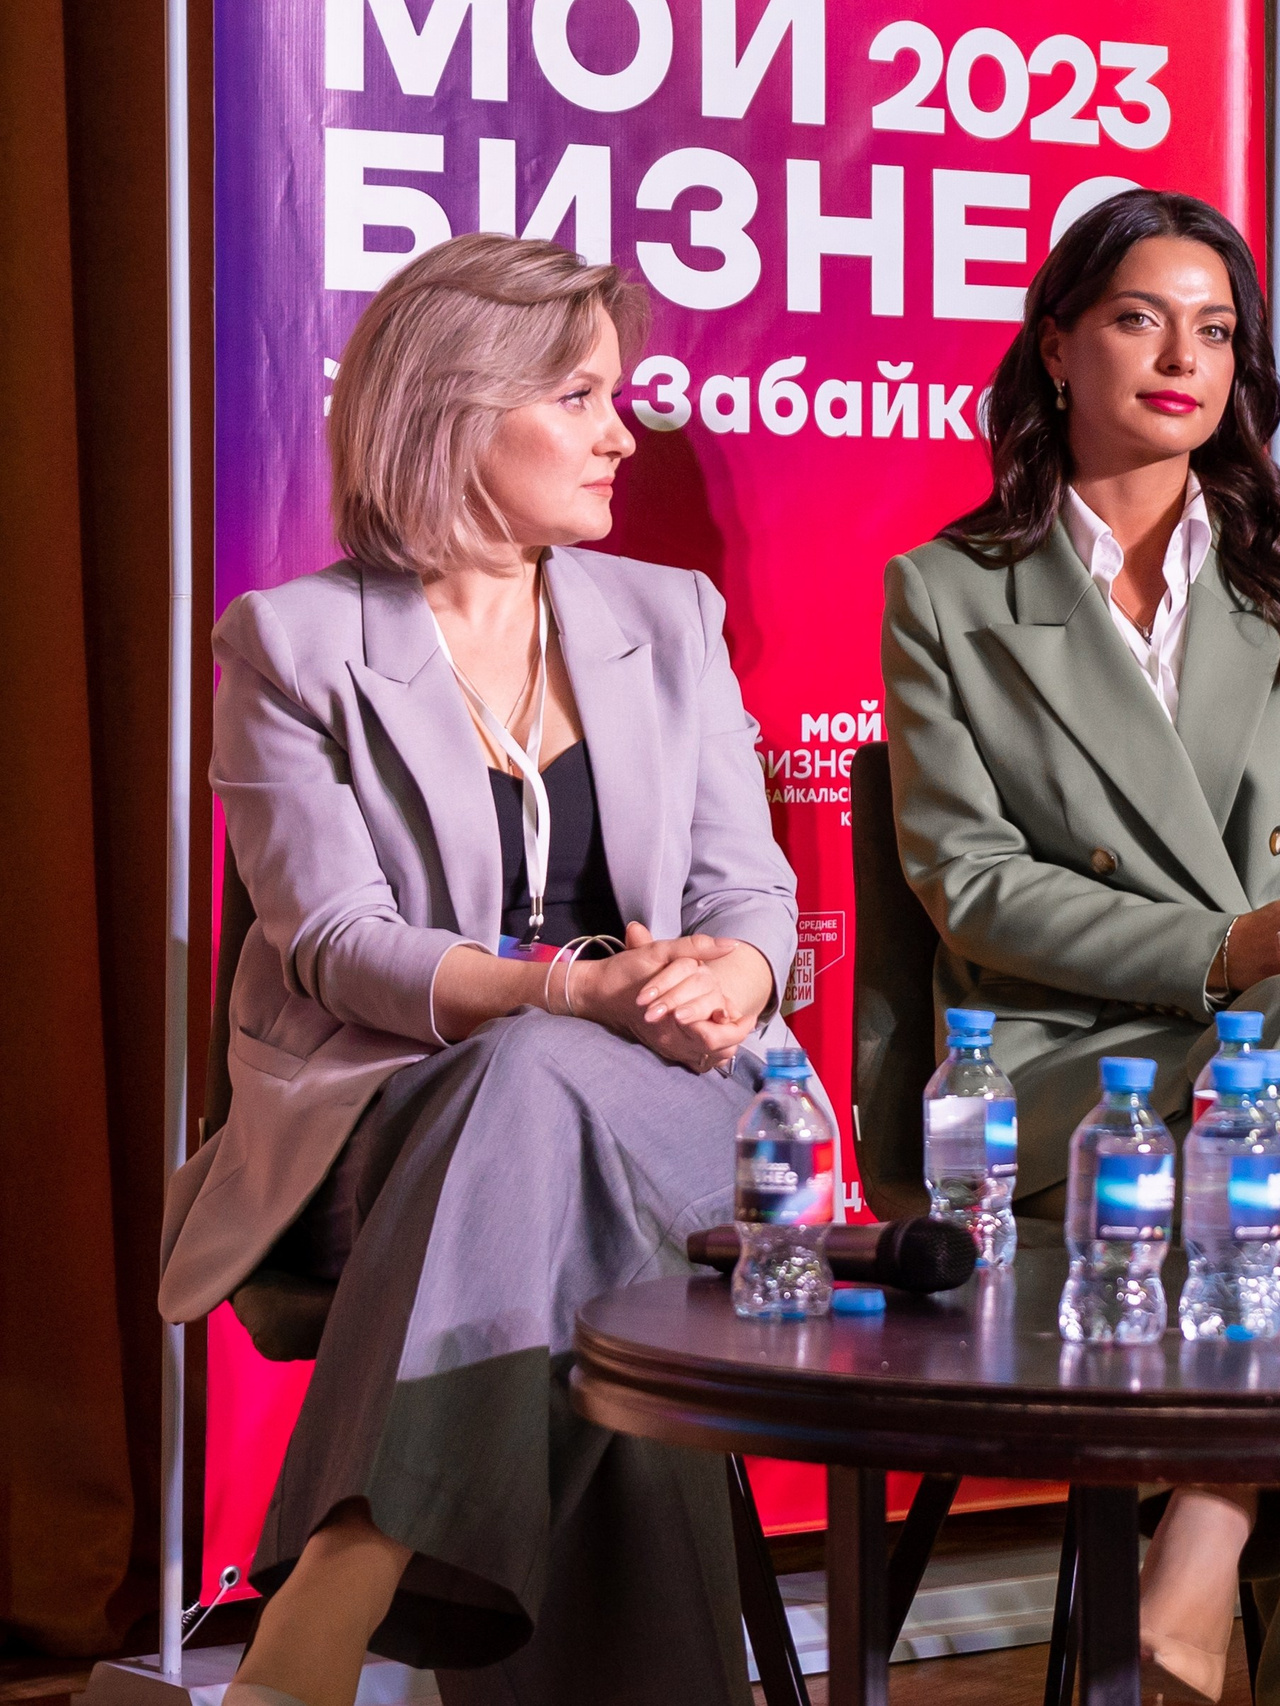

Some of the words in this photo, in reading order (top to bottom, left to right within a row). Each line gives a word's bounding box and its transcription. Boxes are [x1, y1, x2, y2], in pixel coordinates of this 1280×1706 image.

[868, 20, 1171, 150] 2023
[324, 127, 1144, 323] БИЗНЕ
[631, 355, 993, 441] Забайк
[801, 699, 881, 742] МОЙ
[799, 920, 837, 930] СРЕДНЕЕ
